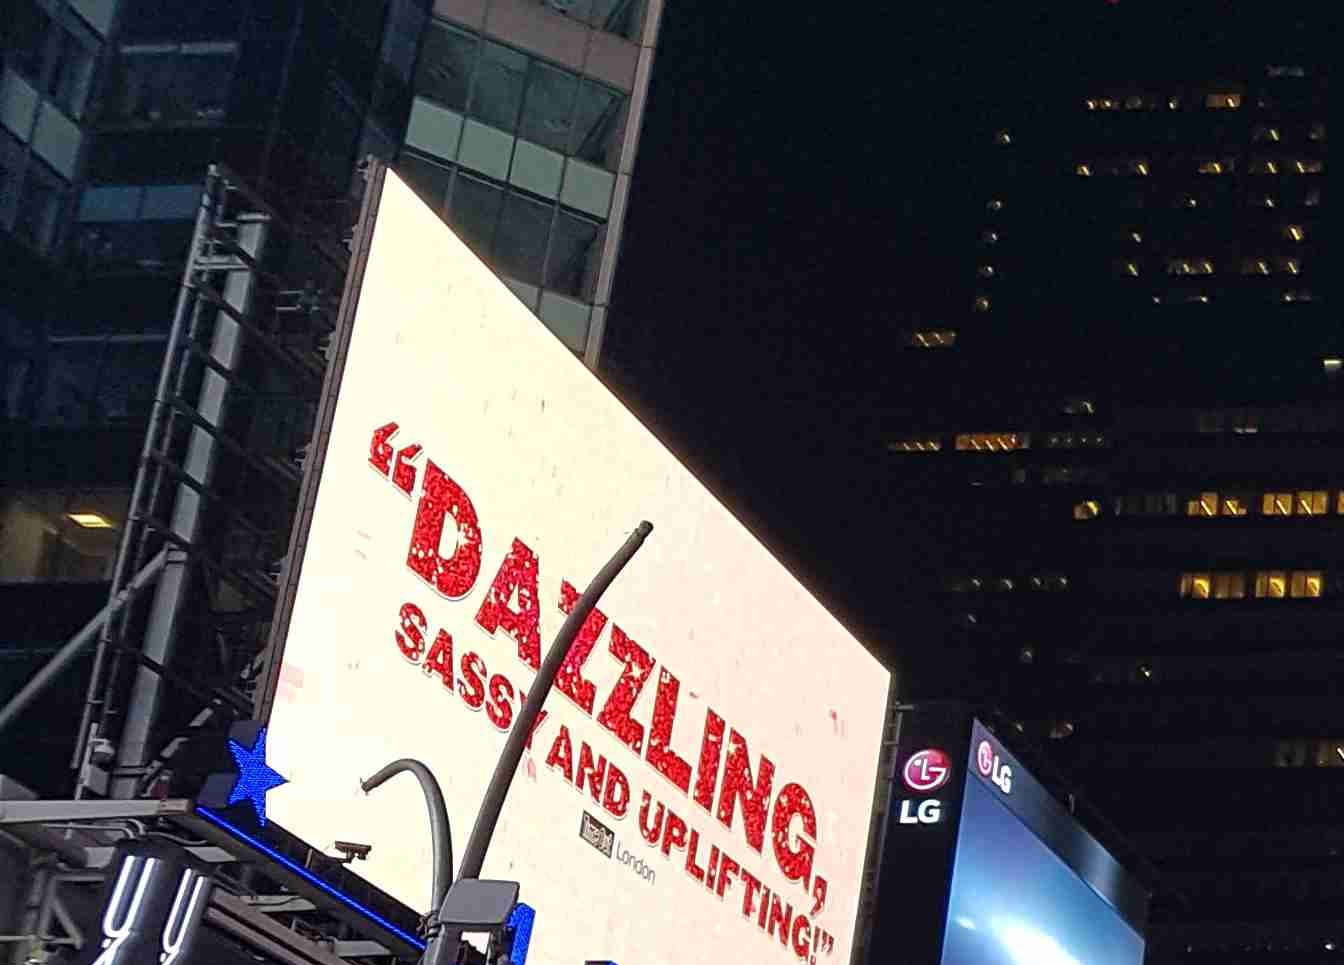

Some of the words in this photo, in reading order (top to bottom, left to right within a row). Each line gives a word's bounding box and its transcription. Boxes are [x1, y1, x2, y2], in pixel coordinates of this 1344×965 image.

[544, 724, 631, 818] AND
[991, 755, 1012, 794] LG
[899, 798, 941, 824] LG
[615, 839, 656, 887] London
